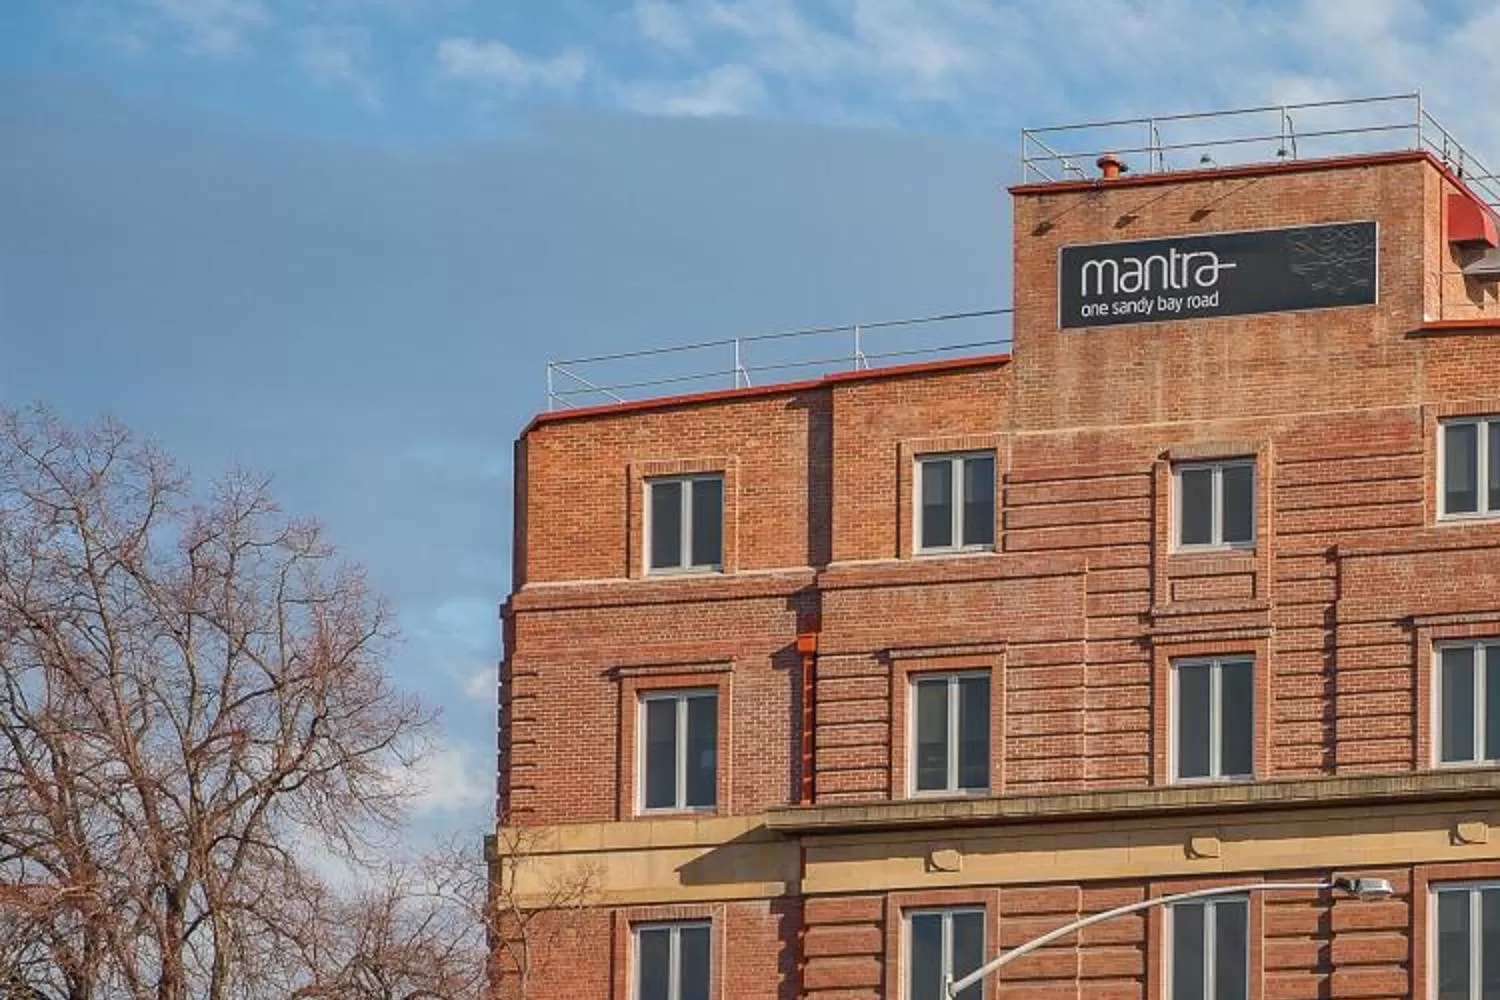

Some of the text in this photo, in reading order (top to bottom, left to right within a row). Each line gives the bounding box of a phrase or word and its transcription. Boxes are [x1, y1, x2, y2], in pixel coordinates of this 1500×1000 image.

[1081, 248, 1237, 297] mantra
[1081, 291, 1219, 317] one sandy bay road
